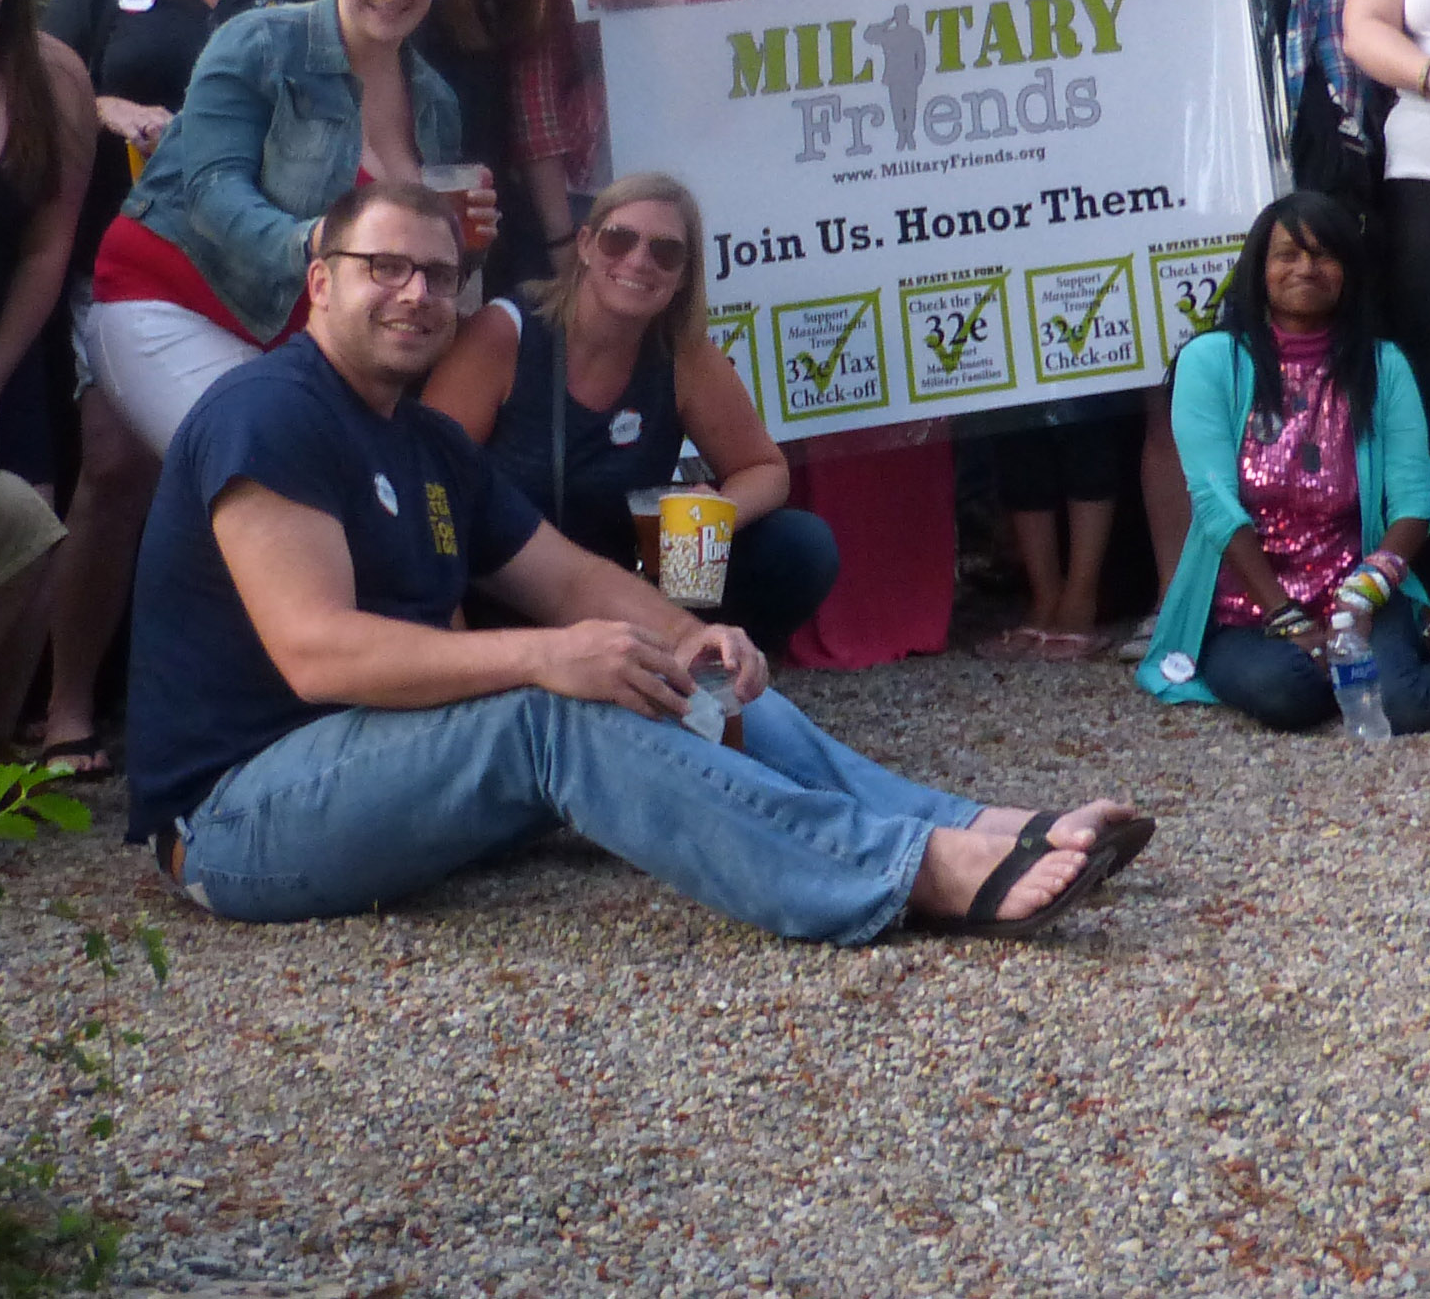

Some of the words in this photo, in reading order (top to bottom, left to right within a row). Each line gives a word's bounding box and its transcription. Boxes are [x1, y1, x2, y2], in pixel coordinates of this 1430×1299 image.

[714, 227, 806, 280] Join
[816, 218, 884, 255] Us.
[895, 202, 1032, 244] Honor
[1041, 185, 1186, 224] Them.
[1148, 243, 1164, 253] MA
[1166, 238, 1200, 251] STATE
[1202, 235, 1222, 246] TAX
[1226, 231, 1250, 243] FOR
[898, 277, 914, 288] MA
[916, 272, 949, 285] STATE
[951, 269, 971, 281] TAX
[974, 264, 1004, 277] FORM
[1056, 273, 1101, 289] Support
[1159, 263, 1198, 278] Check
[1202, 261, 1223, 275] the
[908, 297, 947, 313] Check
[951, 295, 971, 308] the
[1176, 277, 1219, 314] 32
[722, 301, 752, 315] FORM
[803, 308, 848, 325] Support
[925, 312, 988, 349] 32e
[1040, 318, 1084, 346] 32e
[1088, 315, 1132, 338] Tax
[839, 352, 876, 376] Tax
[1045, 342, 1132, 370] Check-off
[791, 379, 877, 409] Check-off
